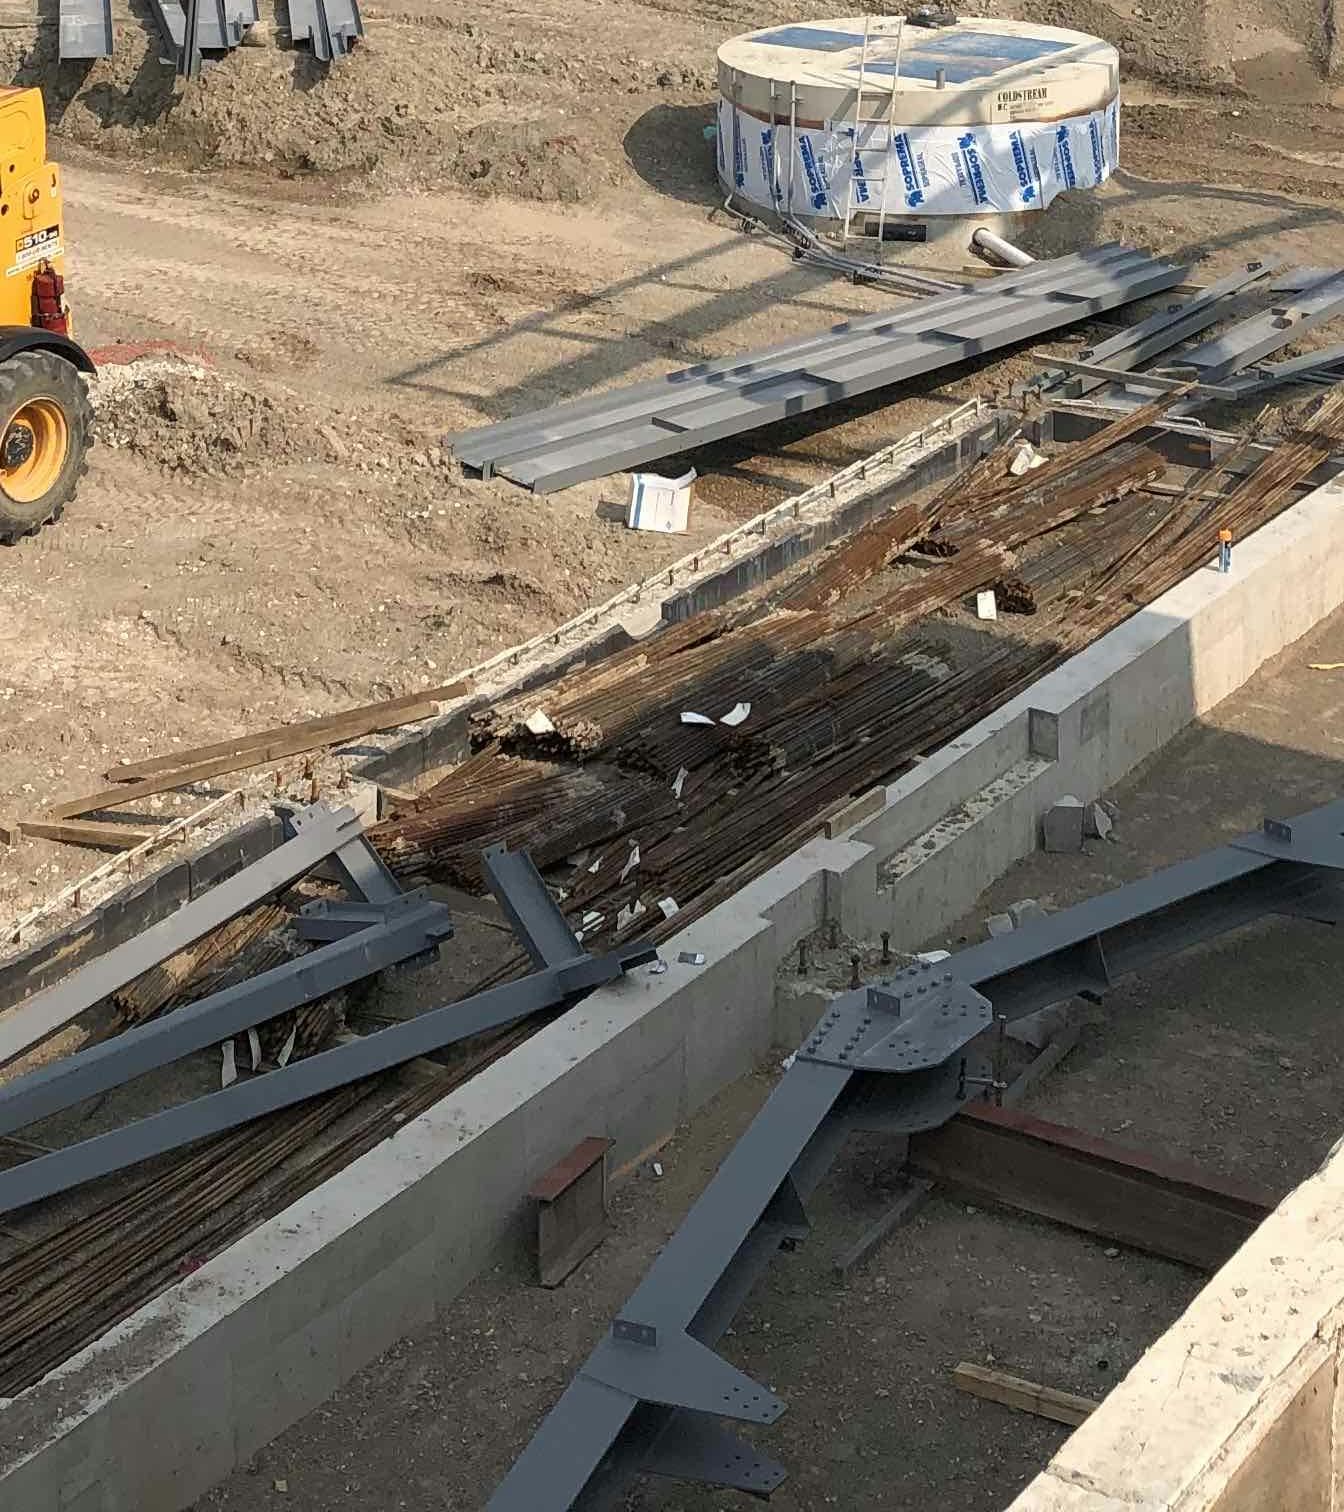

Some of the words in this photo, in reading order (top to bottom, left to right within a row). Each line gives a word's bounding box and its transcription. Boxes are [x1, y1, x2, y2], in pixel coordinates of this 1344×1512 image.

[997, 87, 1048, 102] COLDSTREAM
[895, 134, 915, 191] SOPREMA
[966, 148, 988, 203] SOPREMA
